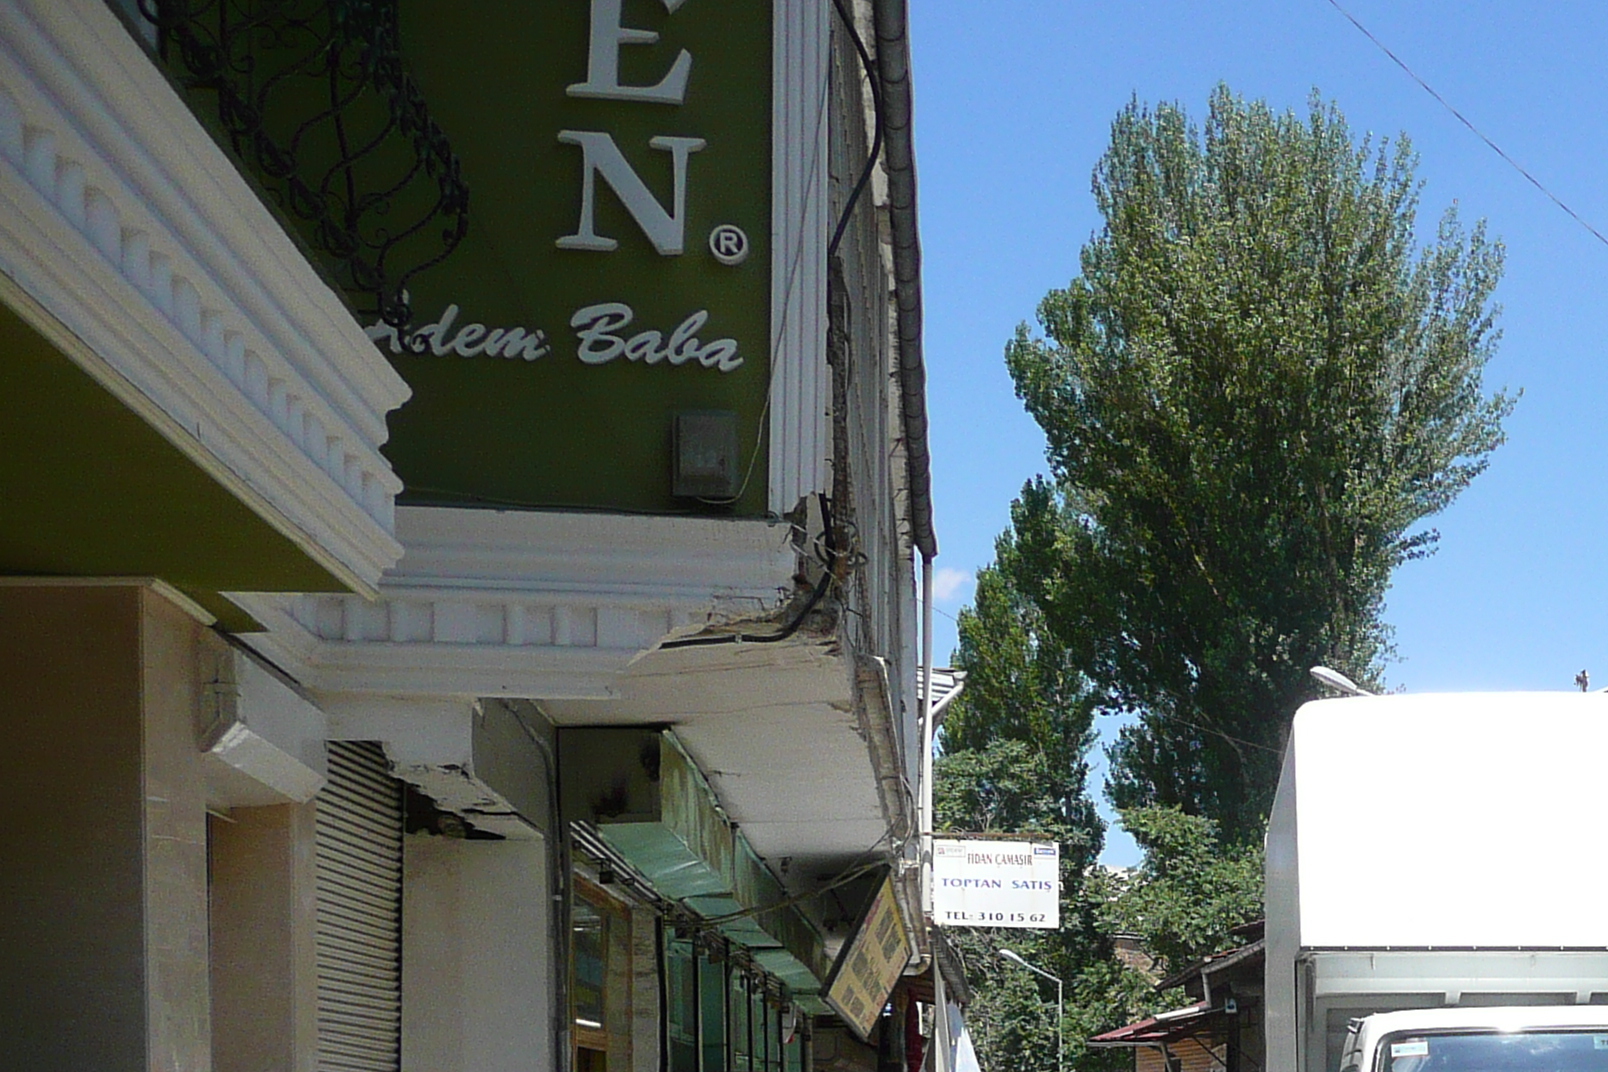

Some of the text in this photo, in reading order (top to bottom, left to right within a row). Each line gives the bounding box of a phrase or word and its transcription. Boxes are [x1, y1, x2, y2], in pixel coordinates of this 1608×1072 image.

[570, 302, 745, 373] Baba
[941, 878, 1053, 893] TOPTAN SATIŞ
[977, 912, 1004, 922] 310
[1010, 912, 1025, 922] 15
[1029, 913, 1046, 923] 62
